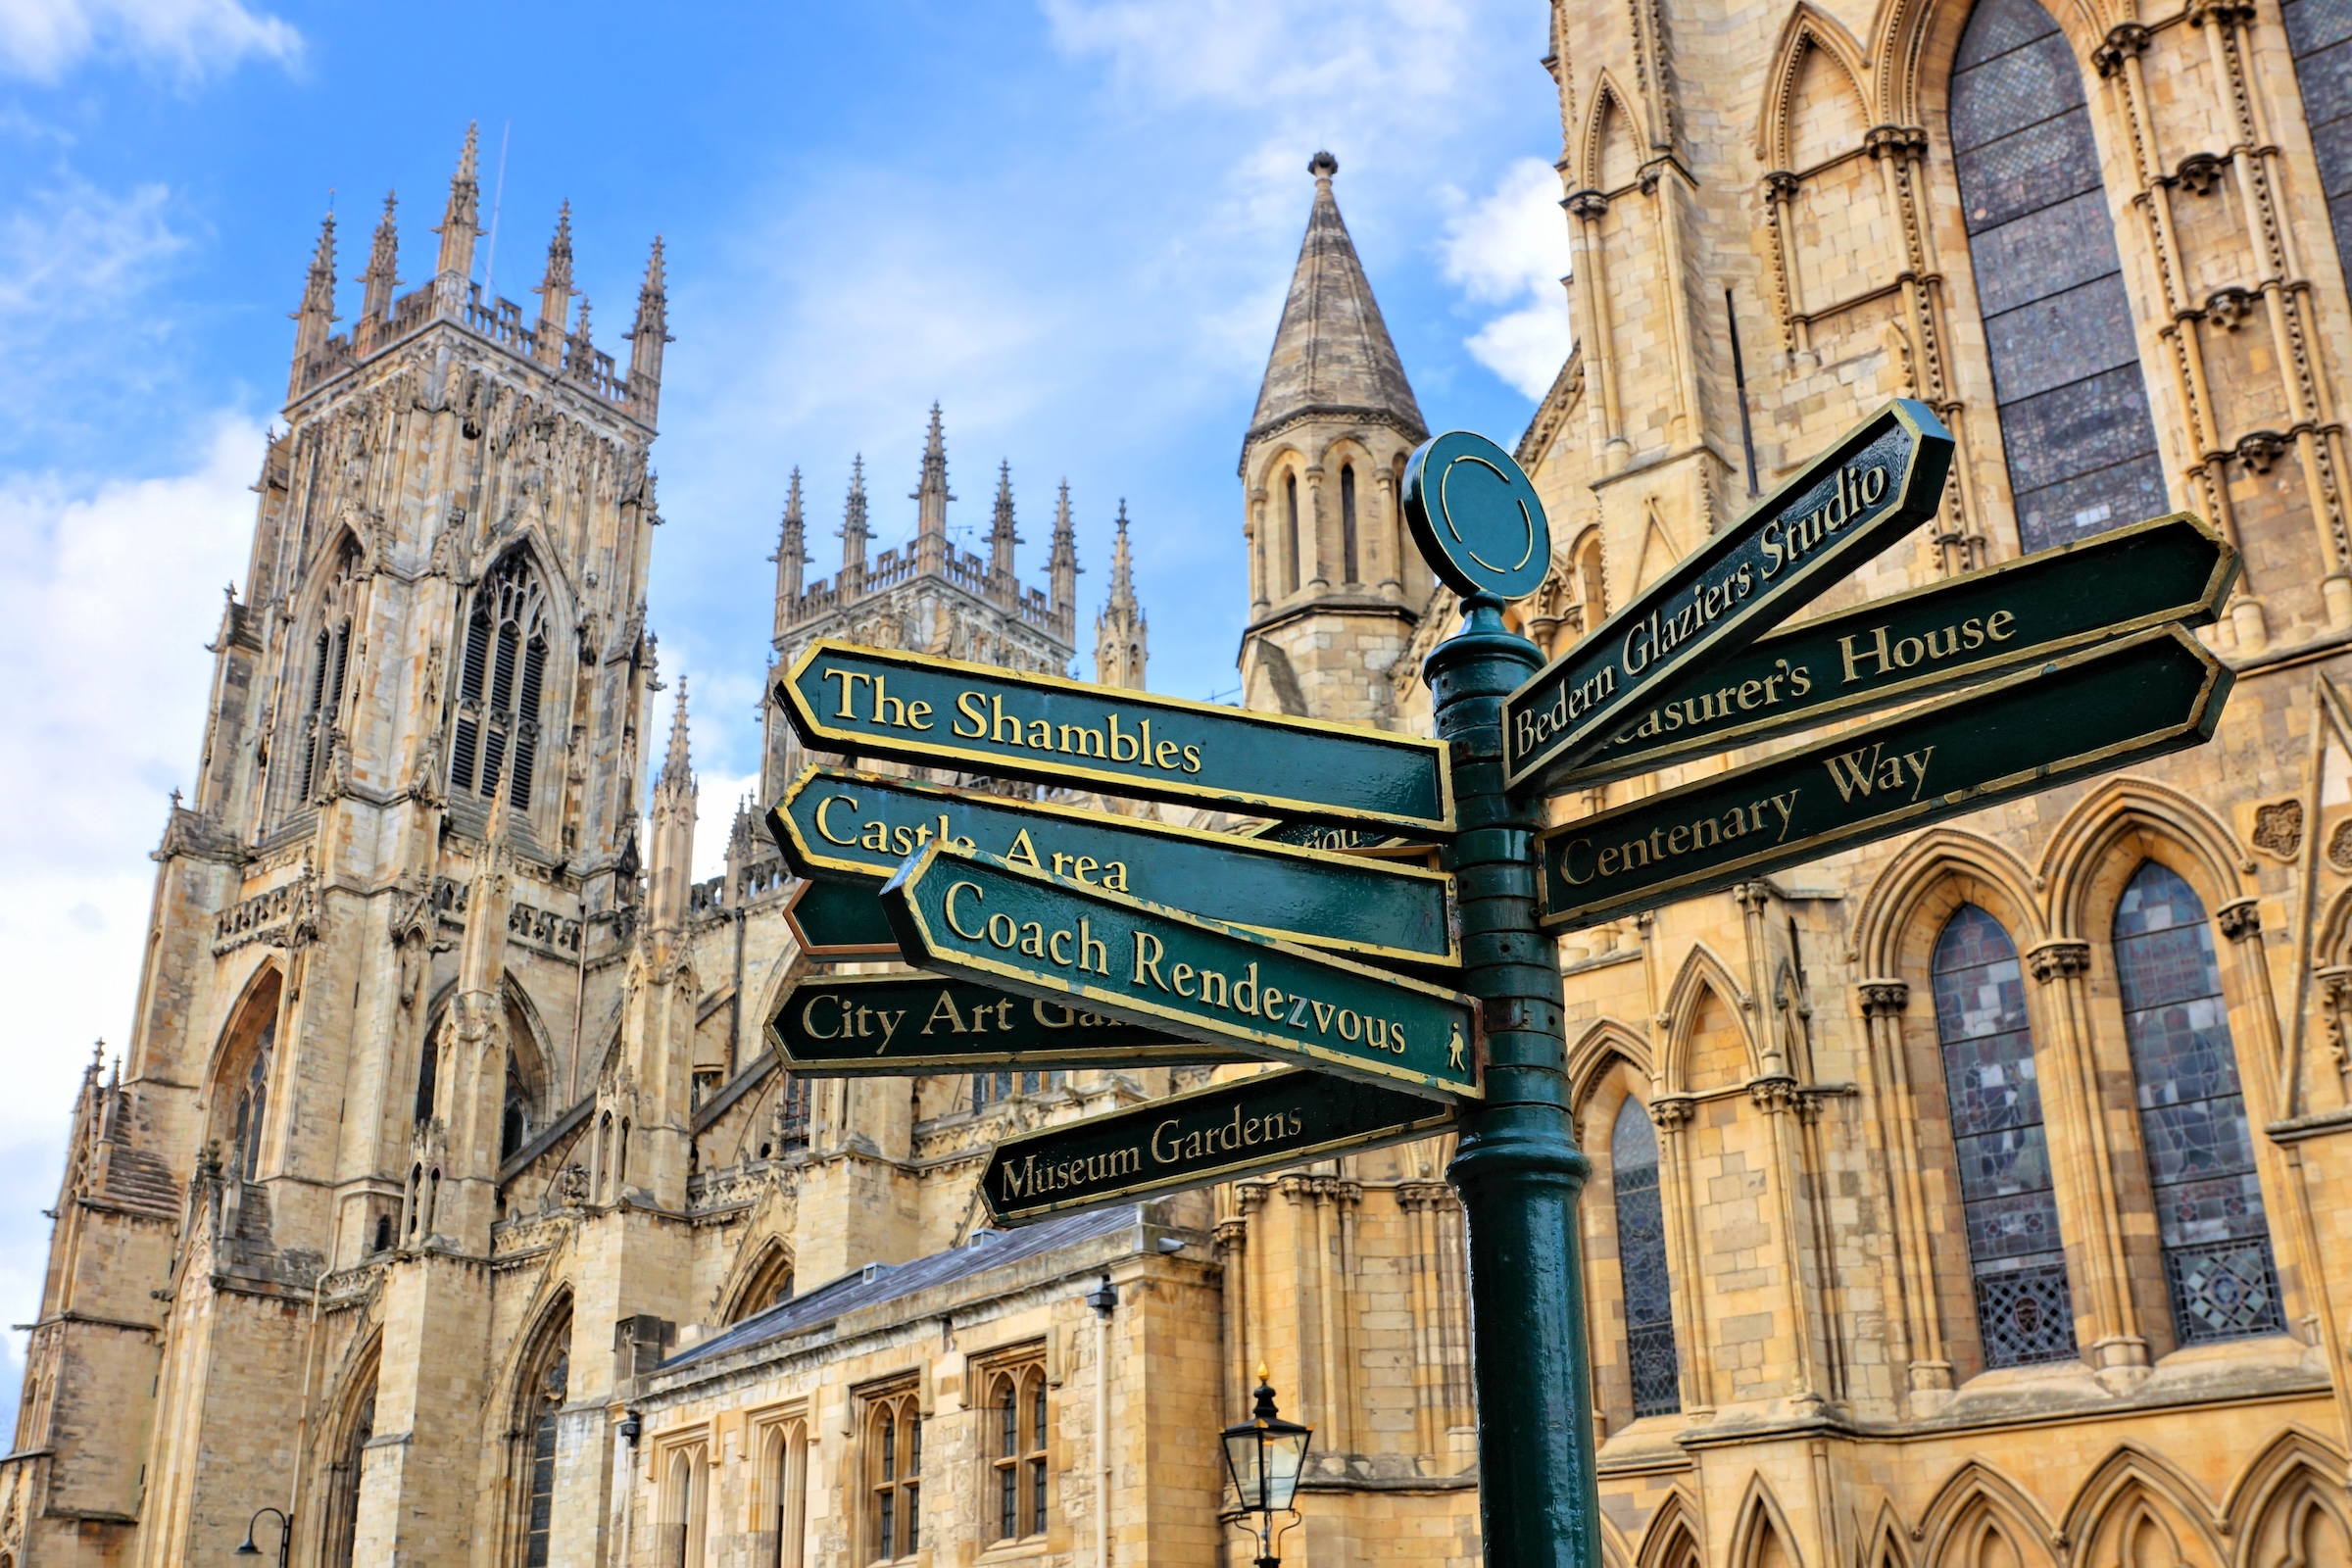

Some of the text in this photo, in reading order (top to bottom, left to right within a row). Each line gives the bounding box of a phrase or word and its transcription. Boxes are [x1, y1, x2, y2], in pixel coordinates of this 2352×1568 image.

[1515, 465, 1888, 760] Bedern Glaziers Studio
[1838, 609, 2017, 684] House
[823, 667, 1202, 773] The Shambles
[1004, 828, 1130, 893] Area
[1560, 743, 1936, 886] Centenary Way
[944, 881, 1406, 1055] Coach Rendezvous
[802, 994, 907, 1055] City
[920, 989, 1015, 1035] Art
[1001, 1103, 1303, 1203] Museum Gardens
